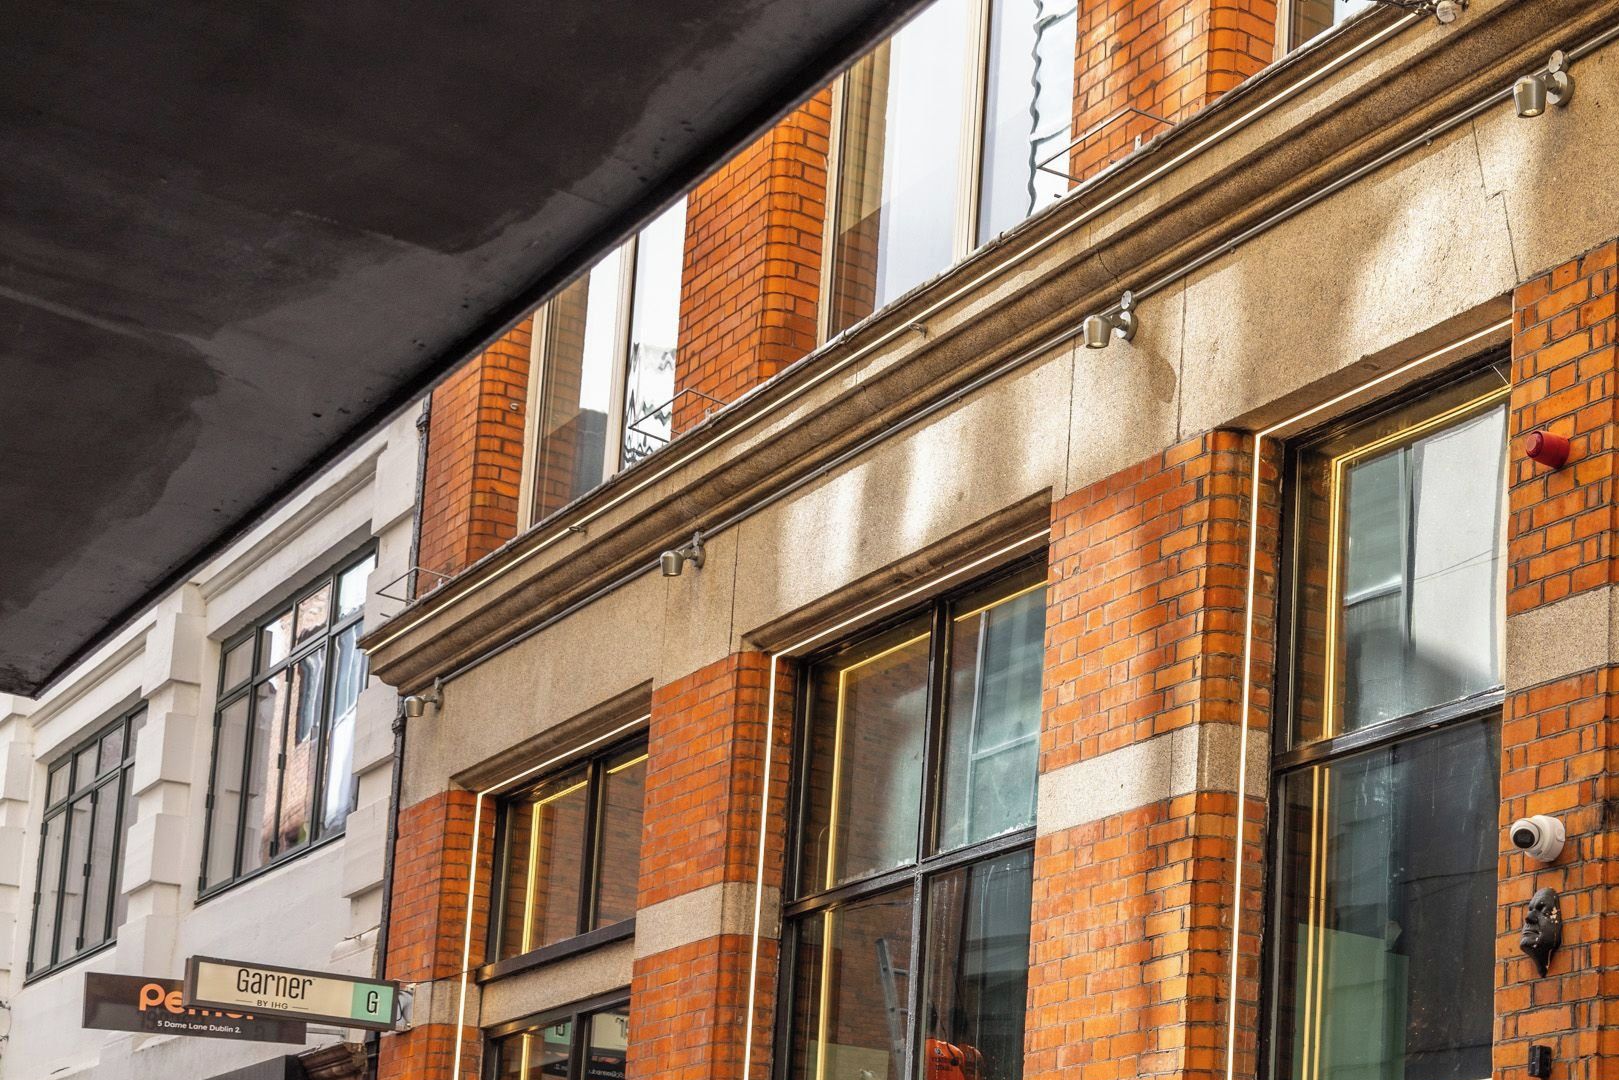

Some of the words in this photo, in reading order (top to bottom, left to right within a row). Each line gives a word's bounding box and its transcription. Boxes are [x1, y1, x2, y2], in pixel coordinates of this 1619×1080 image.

[237, 968, 313, 1000] Garner
[257, 999, 268, 1007] BY
[271, 1001, 288, 1009] IHG
[366, 990, 378, 1014] G
[164, 1021, 187, 1029] Dame
[209, 1025, 233, 1033] Dublin
